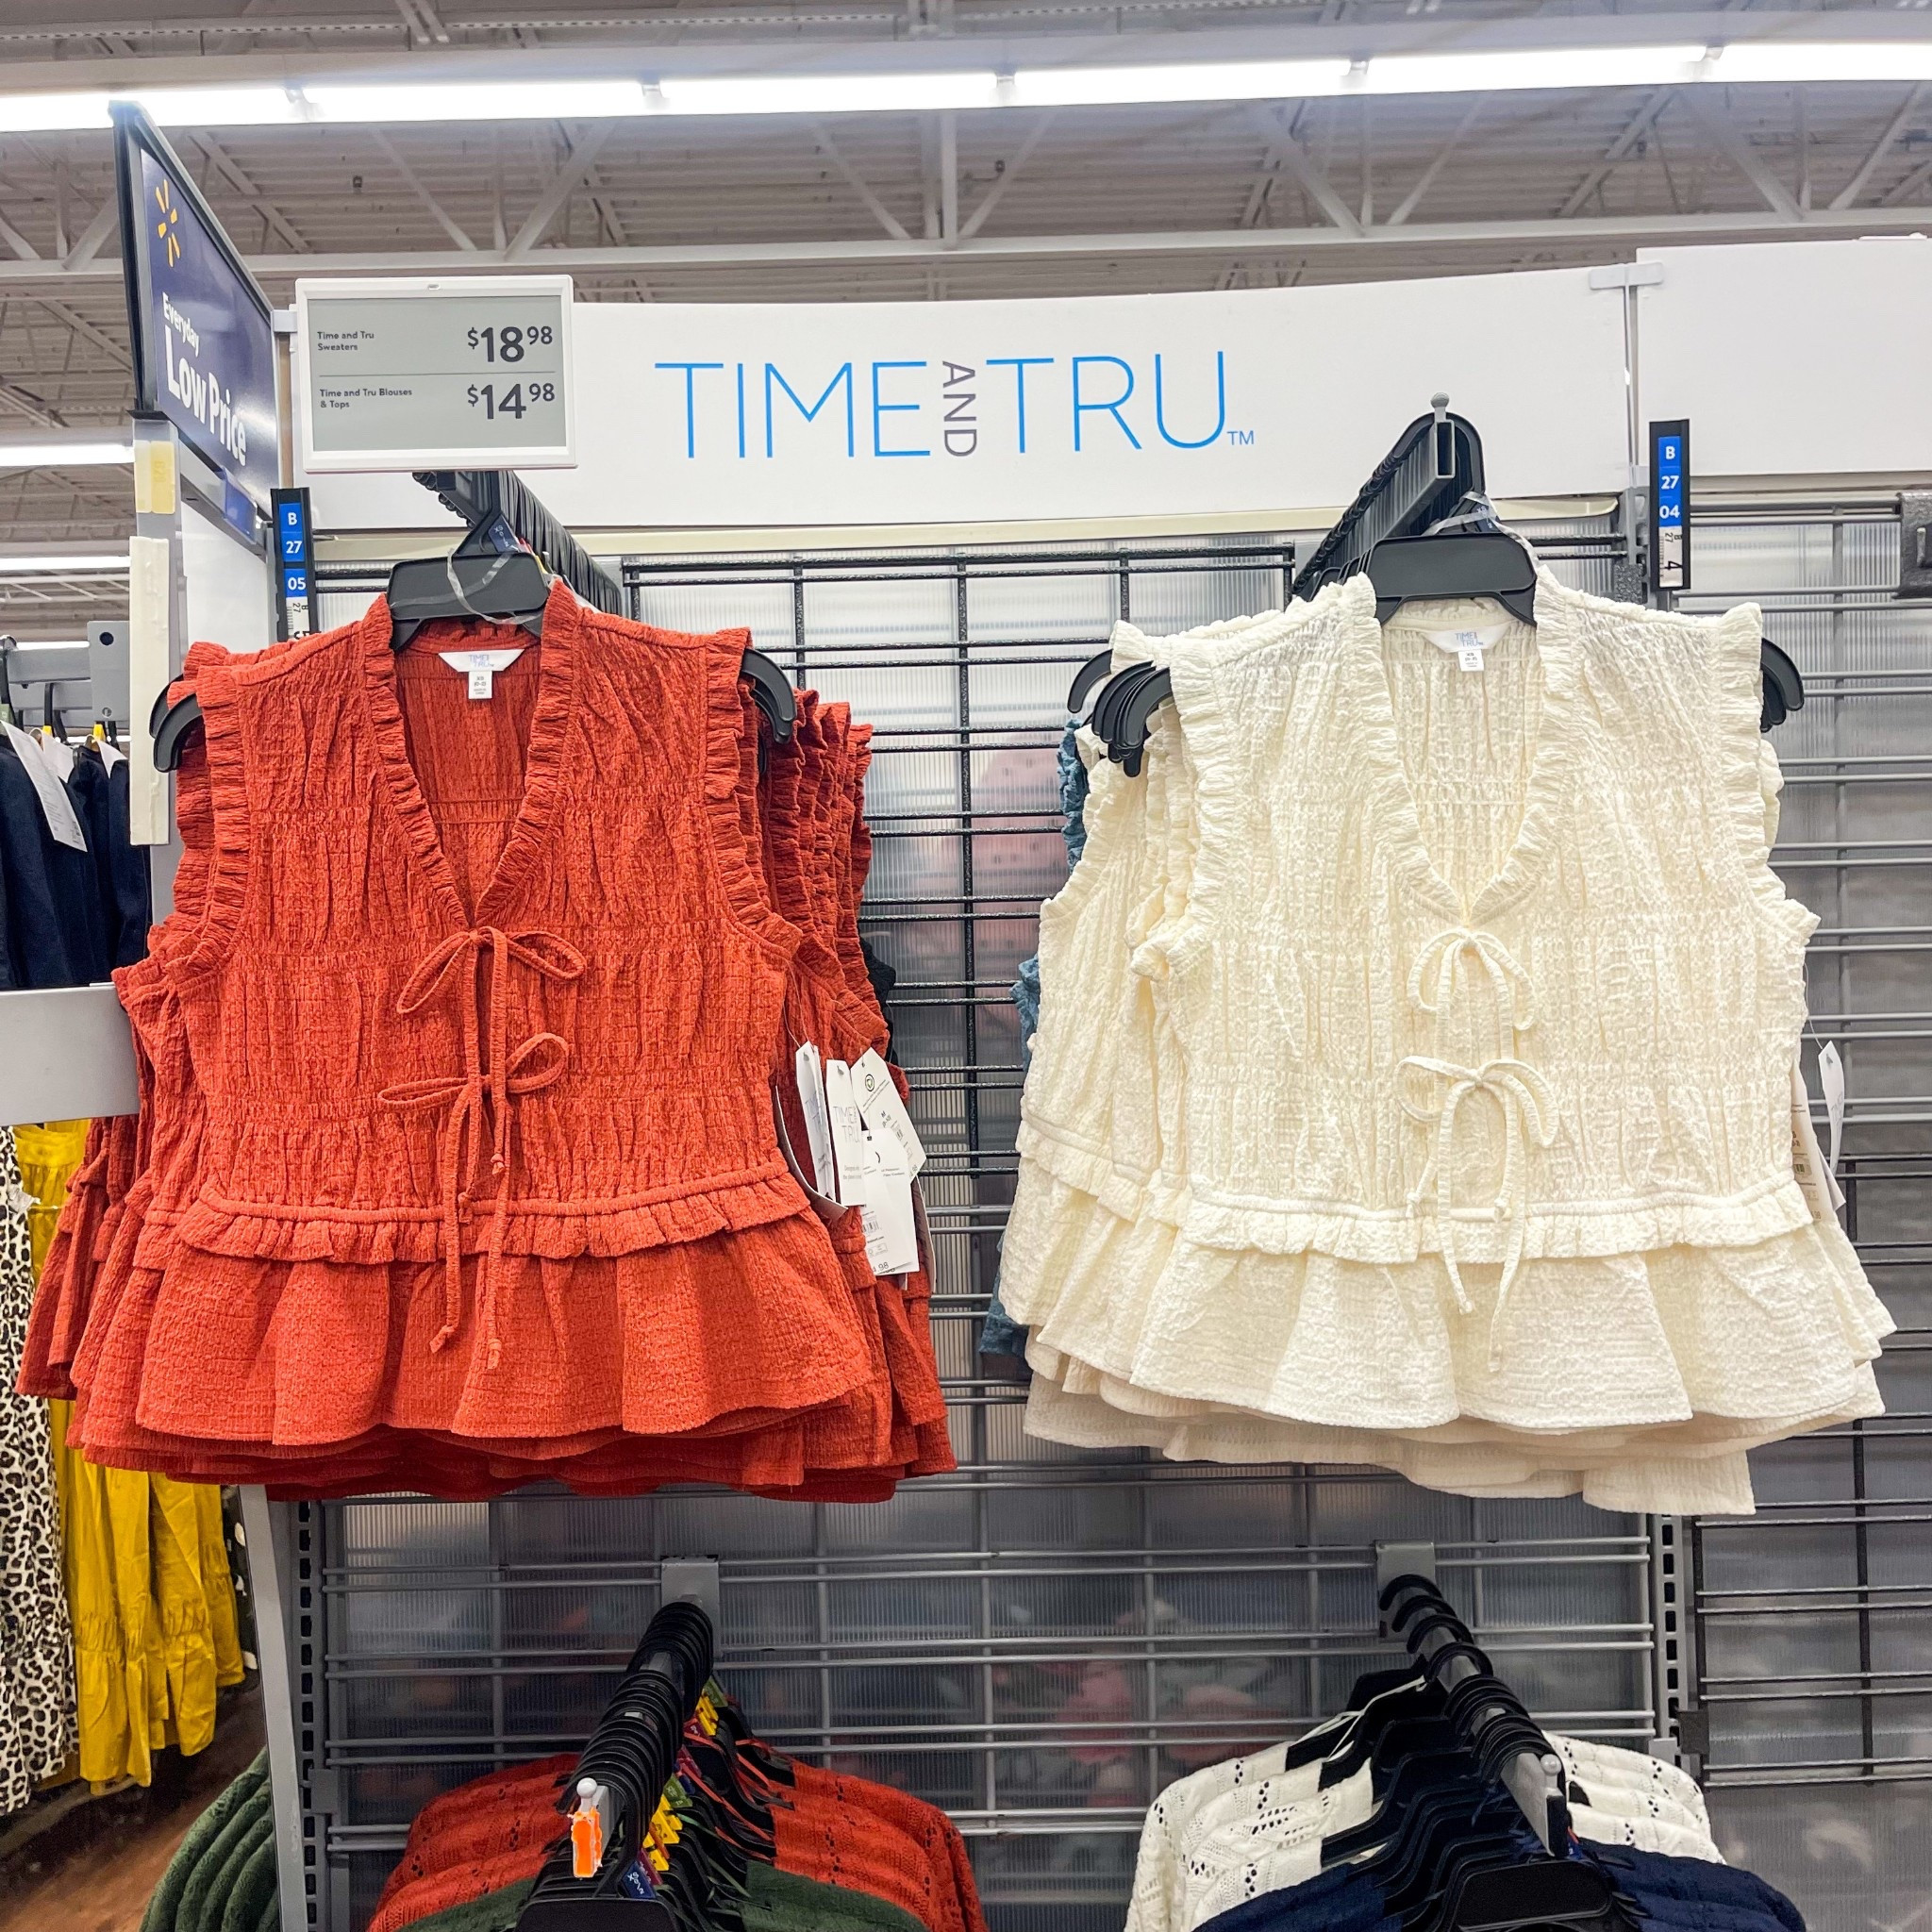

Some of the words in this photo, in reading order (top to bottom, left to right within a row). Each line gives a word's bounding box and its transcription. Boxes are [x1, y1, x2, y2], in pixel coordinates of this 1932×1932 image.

[162, 291, 200, 358] Everyday
[317, 331, 340, 340] Time
[341, 331, 358, 340] and
[359, 331, 375, 340] Tru
[317, 342, 358, 351] Sweaters
[164, 325, 207, 425] Low
[208, 372, 246, 466] Price
[320, 389, 342, 397] Time
[343, 389, 360, 397] and
[363, 388, 377, 397] Tru
[378, 388, 413, 397] Blouses
[320, 400, 327, 408] &
[329, 400, 350, 409] Tops
[655, 361, 931, 458] TIME
[942, 359, 977, 458] AND
[986, 350, 1225, 454] TRU
[1665, 446, 1675, 459] B
[1661, 475, 1679, 490] 27
[288, 512, 298, 525] B
[1659, 505, 1680, 519] 04
[286, 541, 303, 554] 27
[1664, 560, 1683, 571] 4
[288, 577, 307, 591] 05
